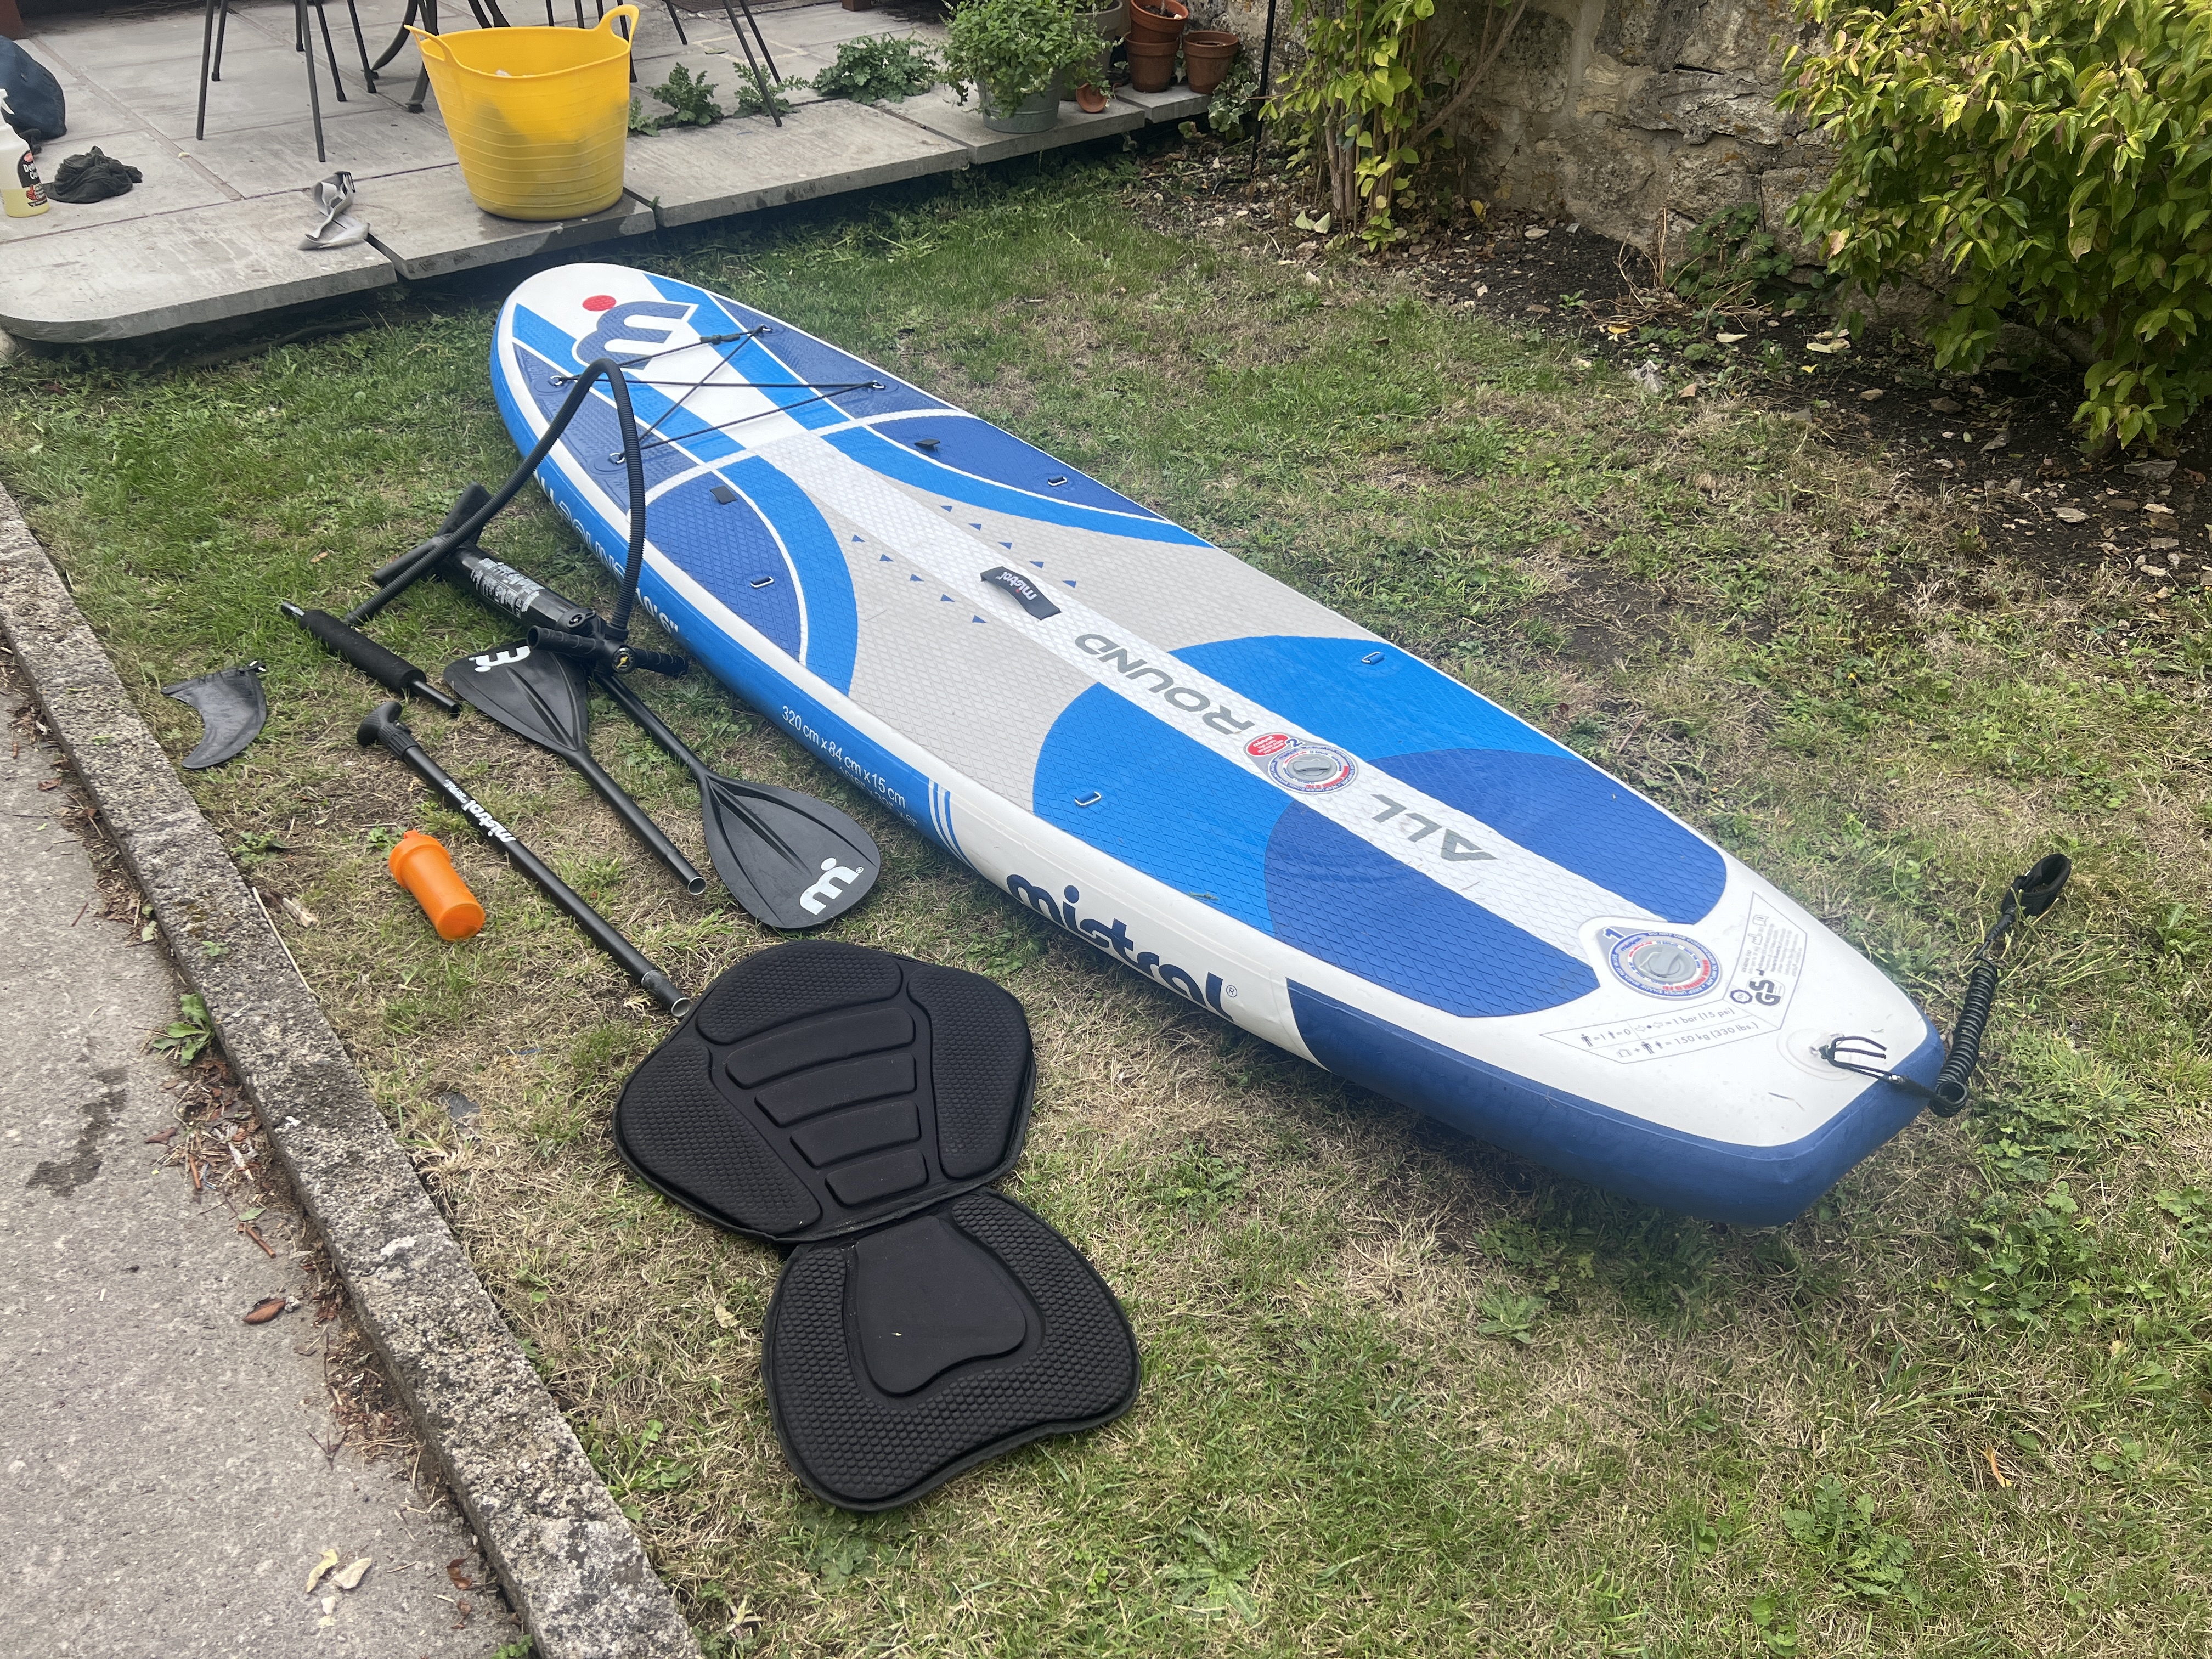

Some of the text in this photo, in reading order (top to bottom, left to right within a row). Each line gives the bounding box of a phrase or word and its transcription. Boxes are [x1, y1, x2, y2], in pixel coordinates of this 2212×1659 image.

[998, 571, 1037, 601] mistral
[1075, 634, 1498, 862] ALL ROUND
[1285, 738, 1304, 748] 2
[782, 706, 906, 809] 320 cm x 84 cm x 15 cm
[462, 799, 516, 842] mistral
[1605, 927, 1624, 940] 1
[1620, 936, 1643, 952] mistral
[1623, 975, 1641, 986] WHEN
[1640, 985, 1662, 994] SHADE
[1718, 1007, 1735, 1018] psi)
[1674, 1035, 1695, 1045] 150
[1710, 1029, 1735, 1039] (330
[1735, 1022, 1759, 1031] lbs.)
